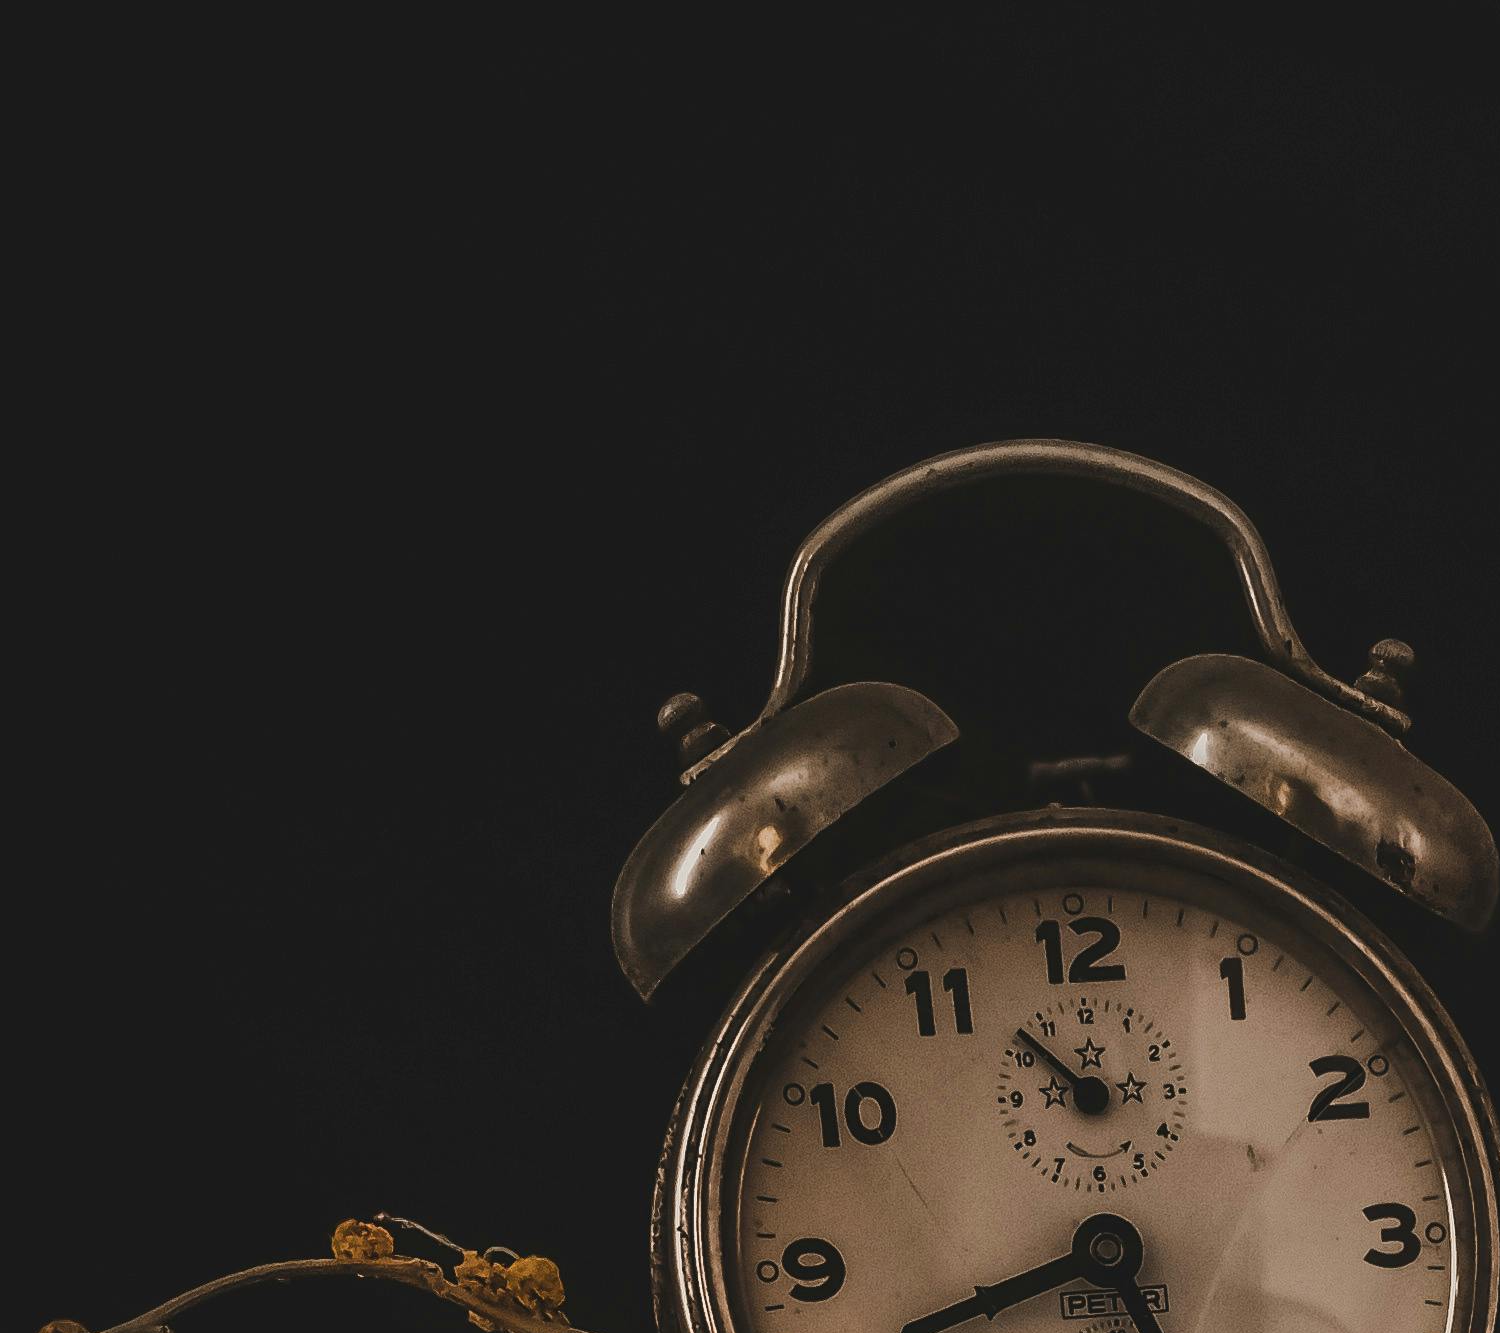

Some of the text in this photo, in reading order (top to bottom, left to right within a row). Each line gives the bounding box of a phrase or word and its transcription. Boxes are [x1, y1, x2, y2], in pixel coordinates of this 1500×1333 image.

[1035, 917, 1126, 984] 12
[1220, 957, 1247, 1020] 1
[904, 968, 974, 1036] 11
[1077, 1008, 1094, 1024] 12
[1040, 1021, 1056, 1037] 11
[1123, 1017, 1131, 1033] 1
[1015, 1051, 1035, 1067] 10
[1148, 1044, 1160, 1062] 2
[1163, 1083, 1176, 1099] 3
[1308, 1054, 1370, 1121] 2
[1010, 1091, 1023, 1107] 9
[810, 1081, 897, 1147] 10
[1023, 1129, 1036, 1146] 8
[1156, 1122, 1169, 1138] 4
[1054, 1157, 1065, 1173] 7
[1133, 1153, 1145, 1170] 5
[1093, 1165, 1106, 1182] 6
[1361, 1202, 1421, 1268] 3
[781, 1237, 846, 1302] 9
[1068, 1289, 1161, 1314] PETR
